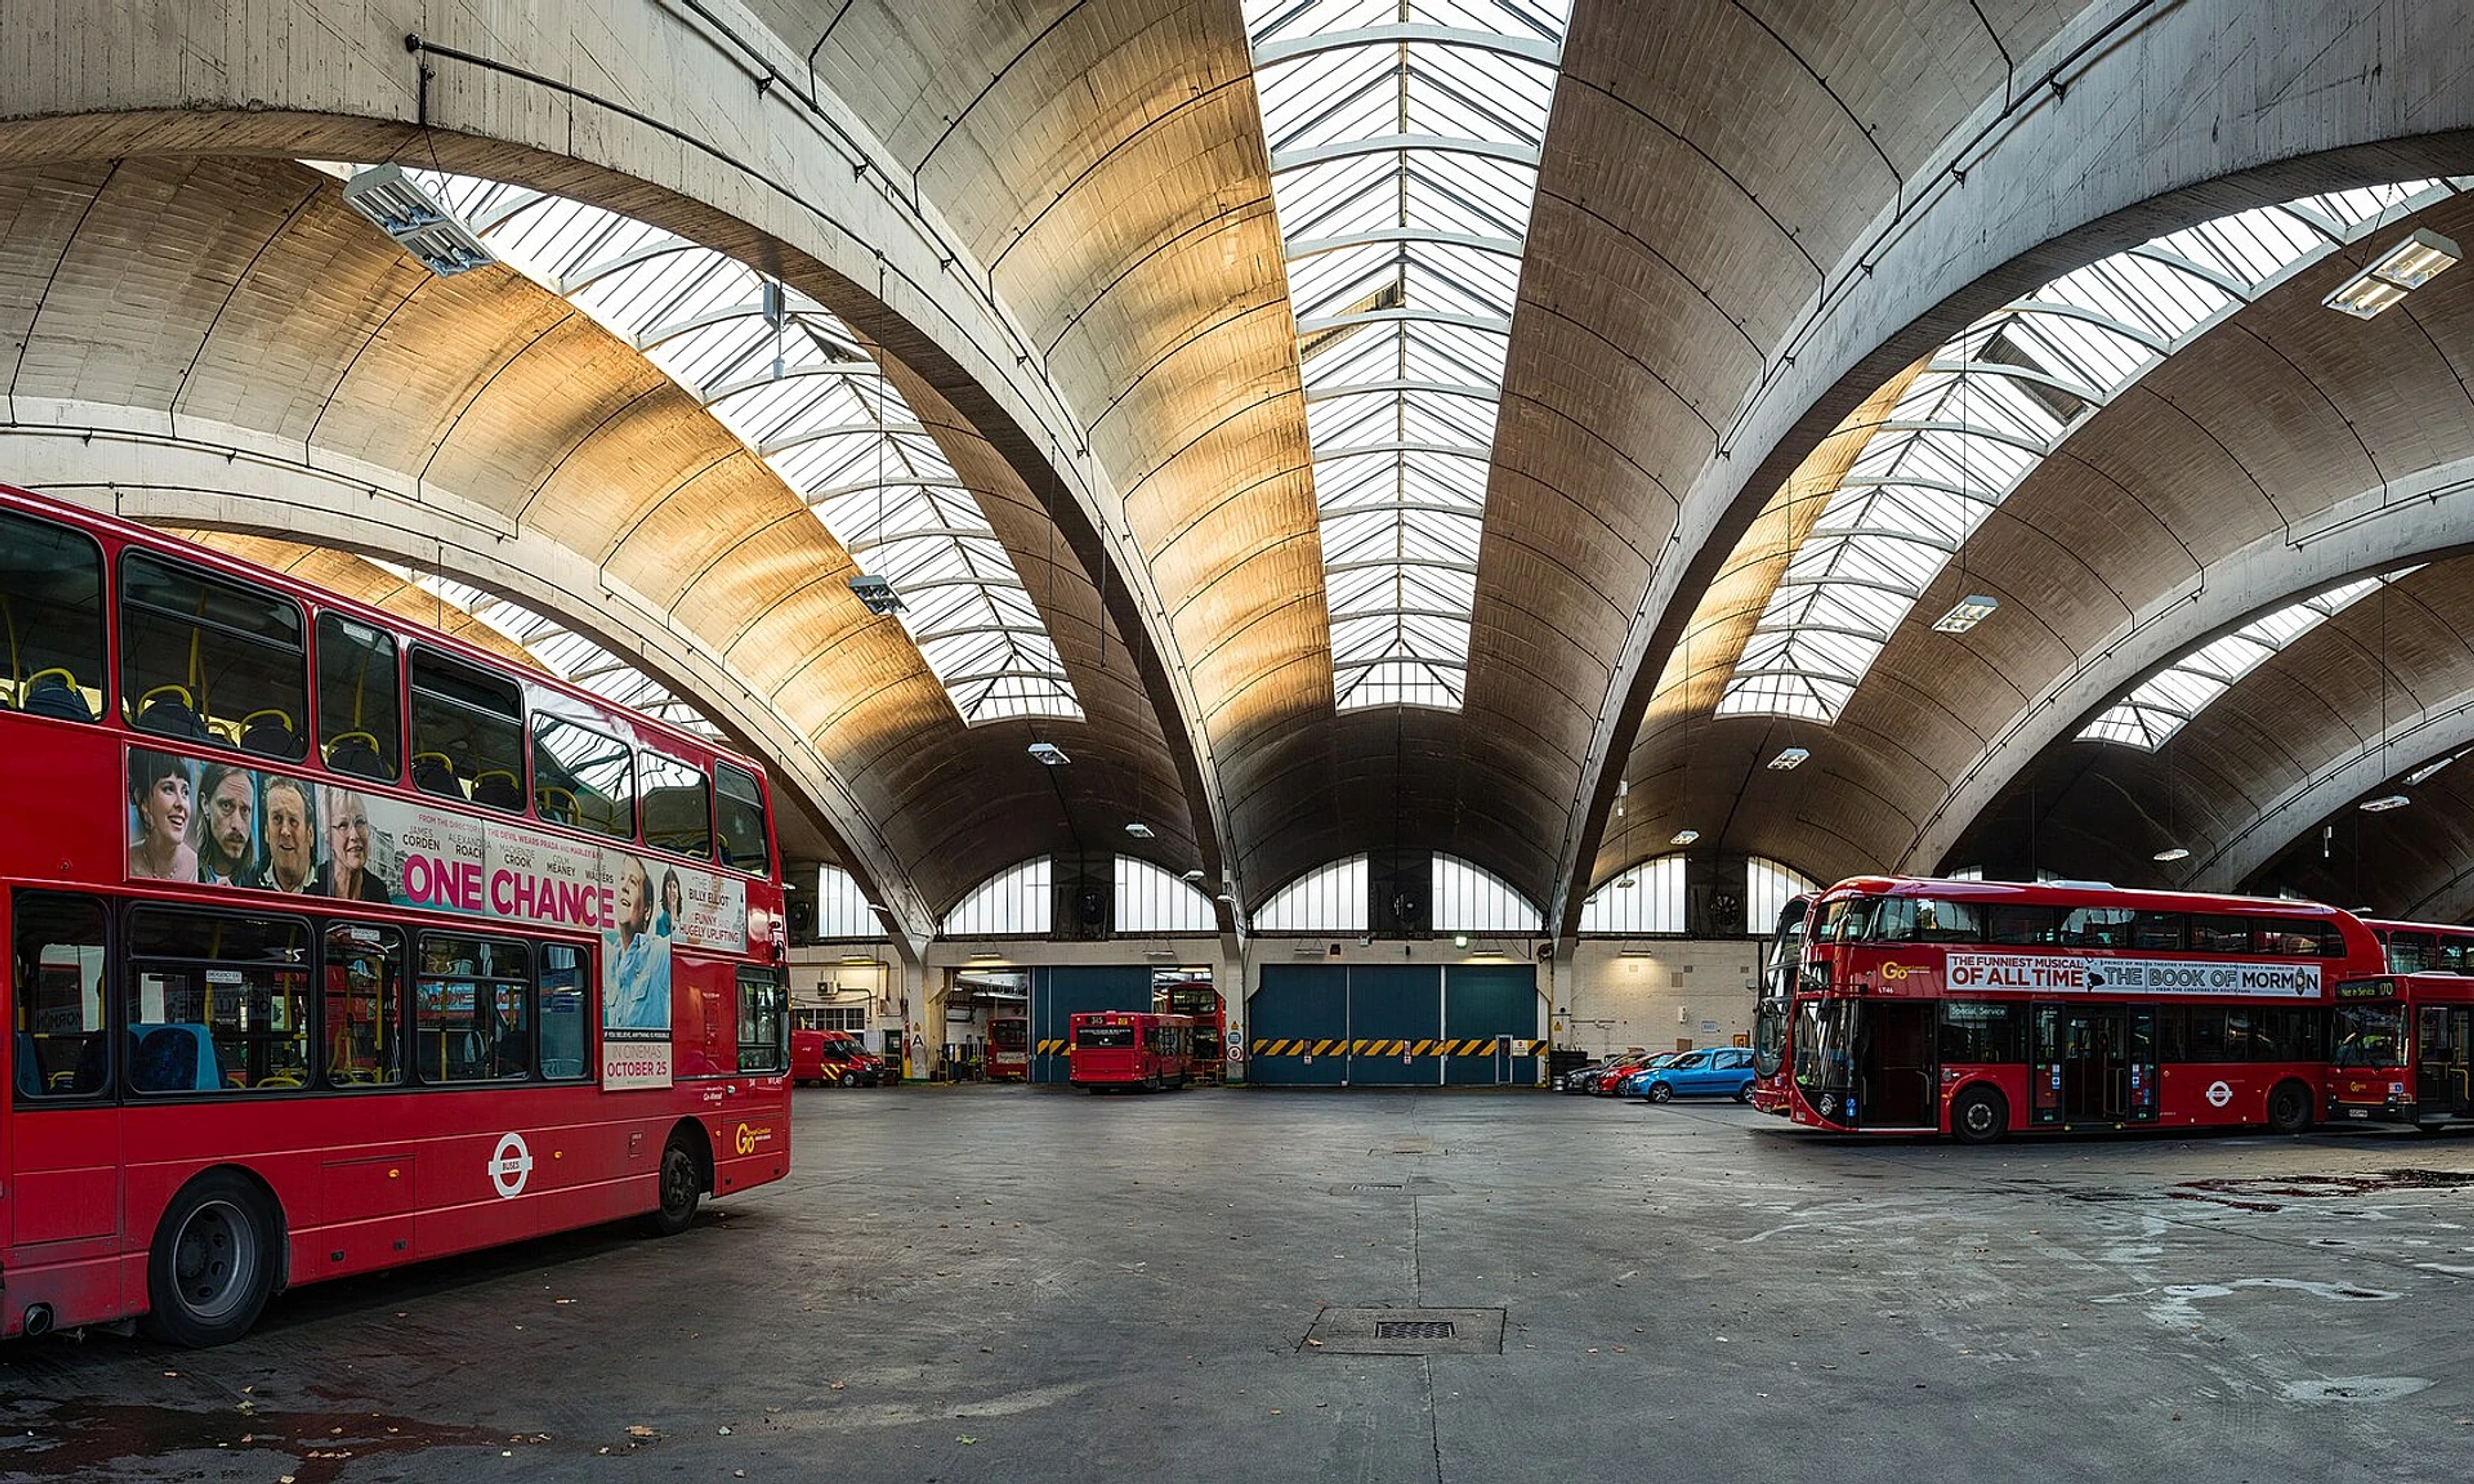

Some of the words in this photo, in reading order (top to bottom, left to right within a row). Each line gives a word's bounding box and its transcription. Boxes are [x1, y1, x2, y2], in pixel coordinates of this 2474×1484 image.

[403, 834, 441, 851] CORDEN
[455, 844, 484, 859] ROACH
[504, 853, 532, 868] CROOK
[546, 862, 575, 877] MEANEY
[403, 854, 482, 911] ONE
[491, 870, 615, 929] CHANCE
[689, 888, 706, 902] BILLY
[679, 923, 706, 937] HUGELY
[1976, 957, 2033, 967] FUNNIEST
[1882, 961, 1908, 980] Go
[1951, 967, 1983, 985] OF
[1986, 967, 2029, 986] ALL
[2031, 969, 2084, 987] TIME
[2104, 967, 2143, 985] THE
[2149, 968, 2205, 987] BOOK
[2210, 970, 2237, 987] OF
[1951, 1006, 1976, 1016] Special
[1979, 1006, 2006, 1016] Service
[912, 1034, 924, 1047] A
[624, 1045, 662, 1059] CINEMAS
[607, 1061, 654, 1078] OCTOBER
[656, 1061, 667, 1076] 25
[736, 1123, 755, 1154] Go
